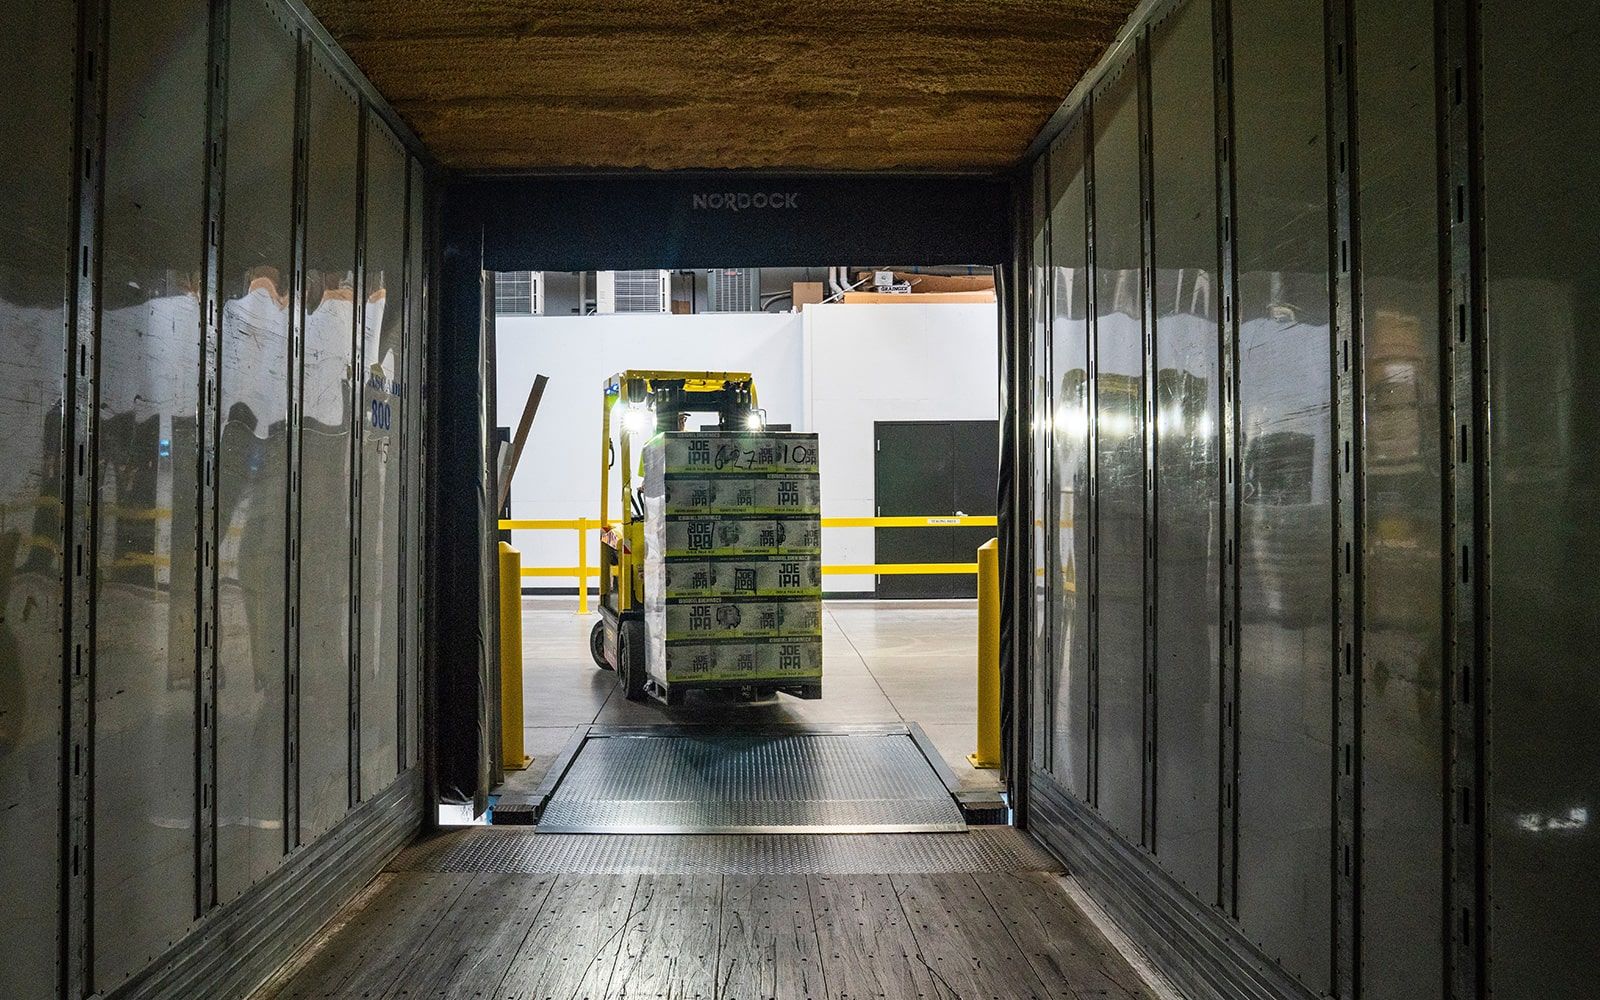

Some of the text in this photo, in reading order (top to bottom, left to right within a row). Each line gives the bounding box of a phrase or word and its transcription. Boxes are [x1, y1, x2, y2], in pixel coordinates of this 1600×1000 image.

[692, 192, 799, 211] NORDOCK
[372, 399, 391, 430] 800
[688, 440, 709, 450] JOE
[688, 452, 709, 464] IPA
[759, 456, 773, 464] IPA
[778, 482, 798, 491] JOE
[691, 497, 706, 506] IPA
[737, 497, 752, 505] IPA
[778, 493, 798, 505] IPA
[689, 524, 710, 533] JOE
[689, 534, 711, 548] IPA
[760, 538, 774, 546] IPA
[804, 537, 819, 546] IPA
[779, 563, 799, 573] JOE
[693, 580, 708, 589] IPA
[737, 580, 753, 589] IPA
[779, 574, 800, 587] IPA
[689, 606, 711, 616] JOE
[689, 617, 711, 630] IPA
[760, 620, 775, 629] IPA
[779, 645, 801, 655] JOE
[693, 655, 708, 663] JOE
[780, 656, 801, 669] IPA
[693, 663, 708, 672] IPA
[738, 662, 753, 671] IPA
